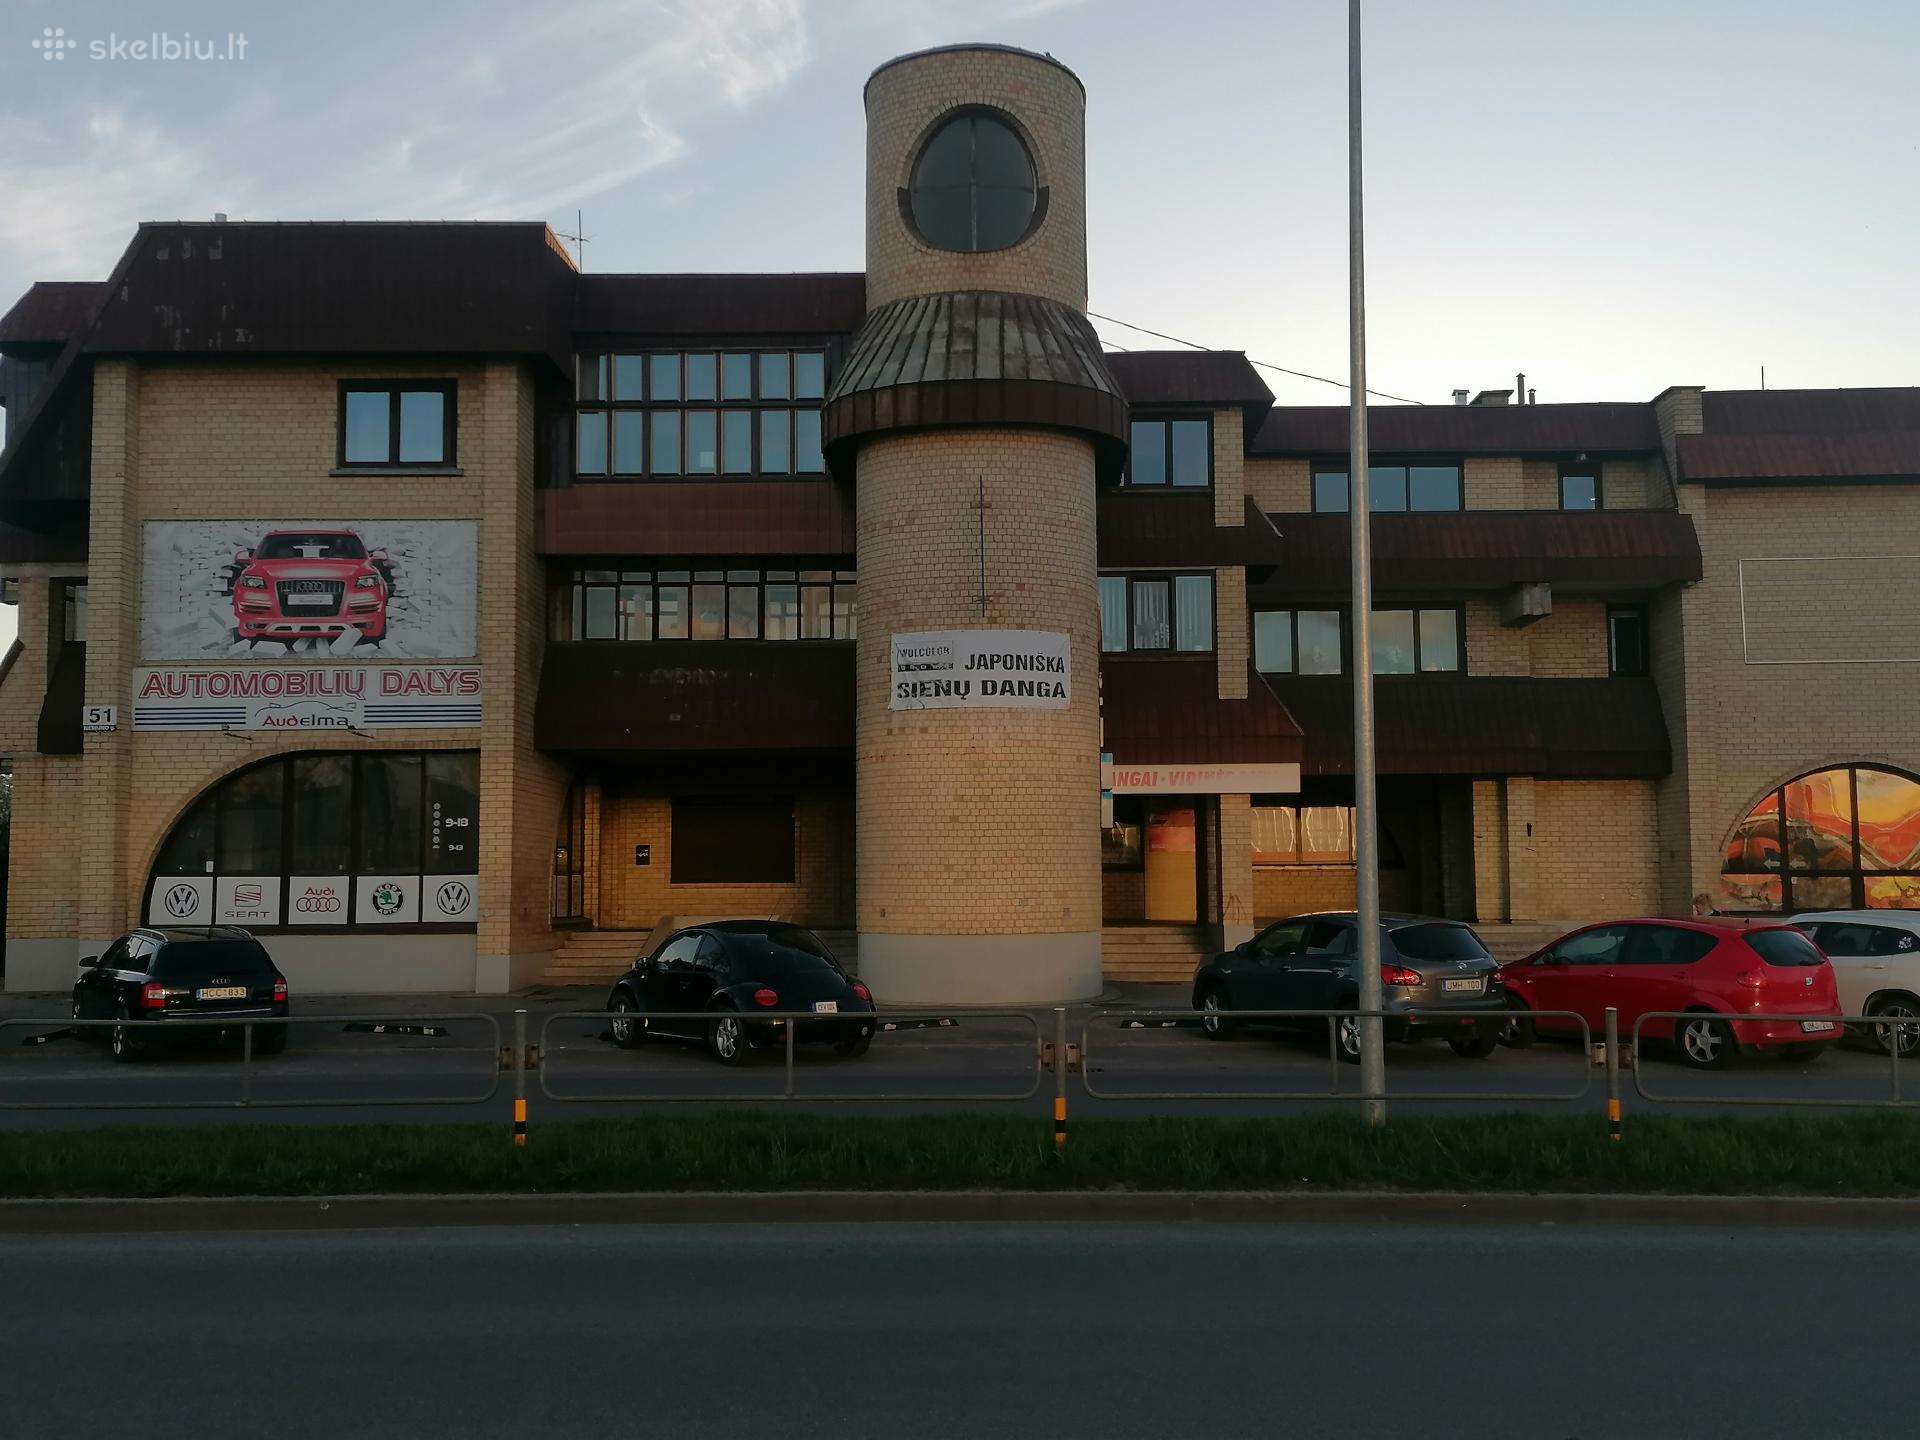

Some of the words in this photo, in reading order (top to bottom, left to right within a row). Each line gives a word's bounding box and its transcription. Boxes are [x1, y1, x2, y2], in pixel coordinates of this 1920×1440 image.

[965, 652, 1065, 673] JAPONIŠKA
[139, 669, 365, 700] AUTOMOBILIŲ
[380, 669, 481, 696] DALYS
[897, 680, 970, 700] SIENŲ
[981, 680, 1066, 698] DANGA
[89, 708, 111, 723] 51
[445, 817, 469, 828] 9-18
[304, 887, 335, 896] Audi
